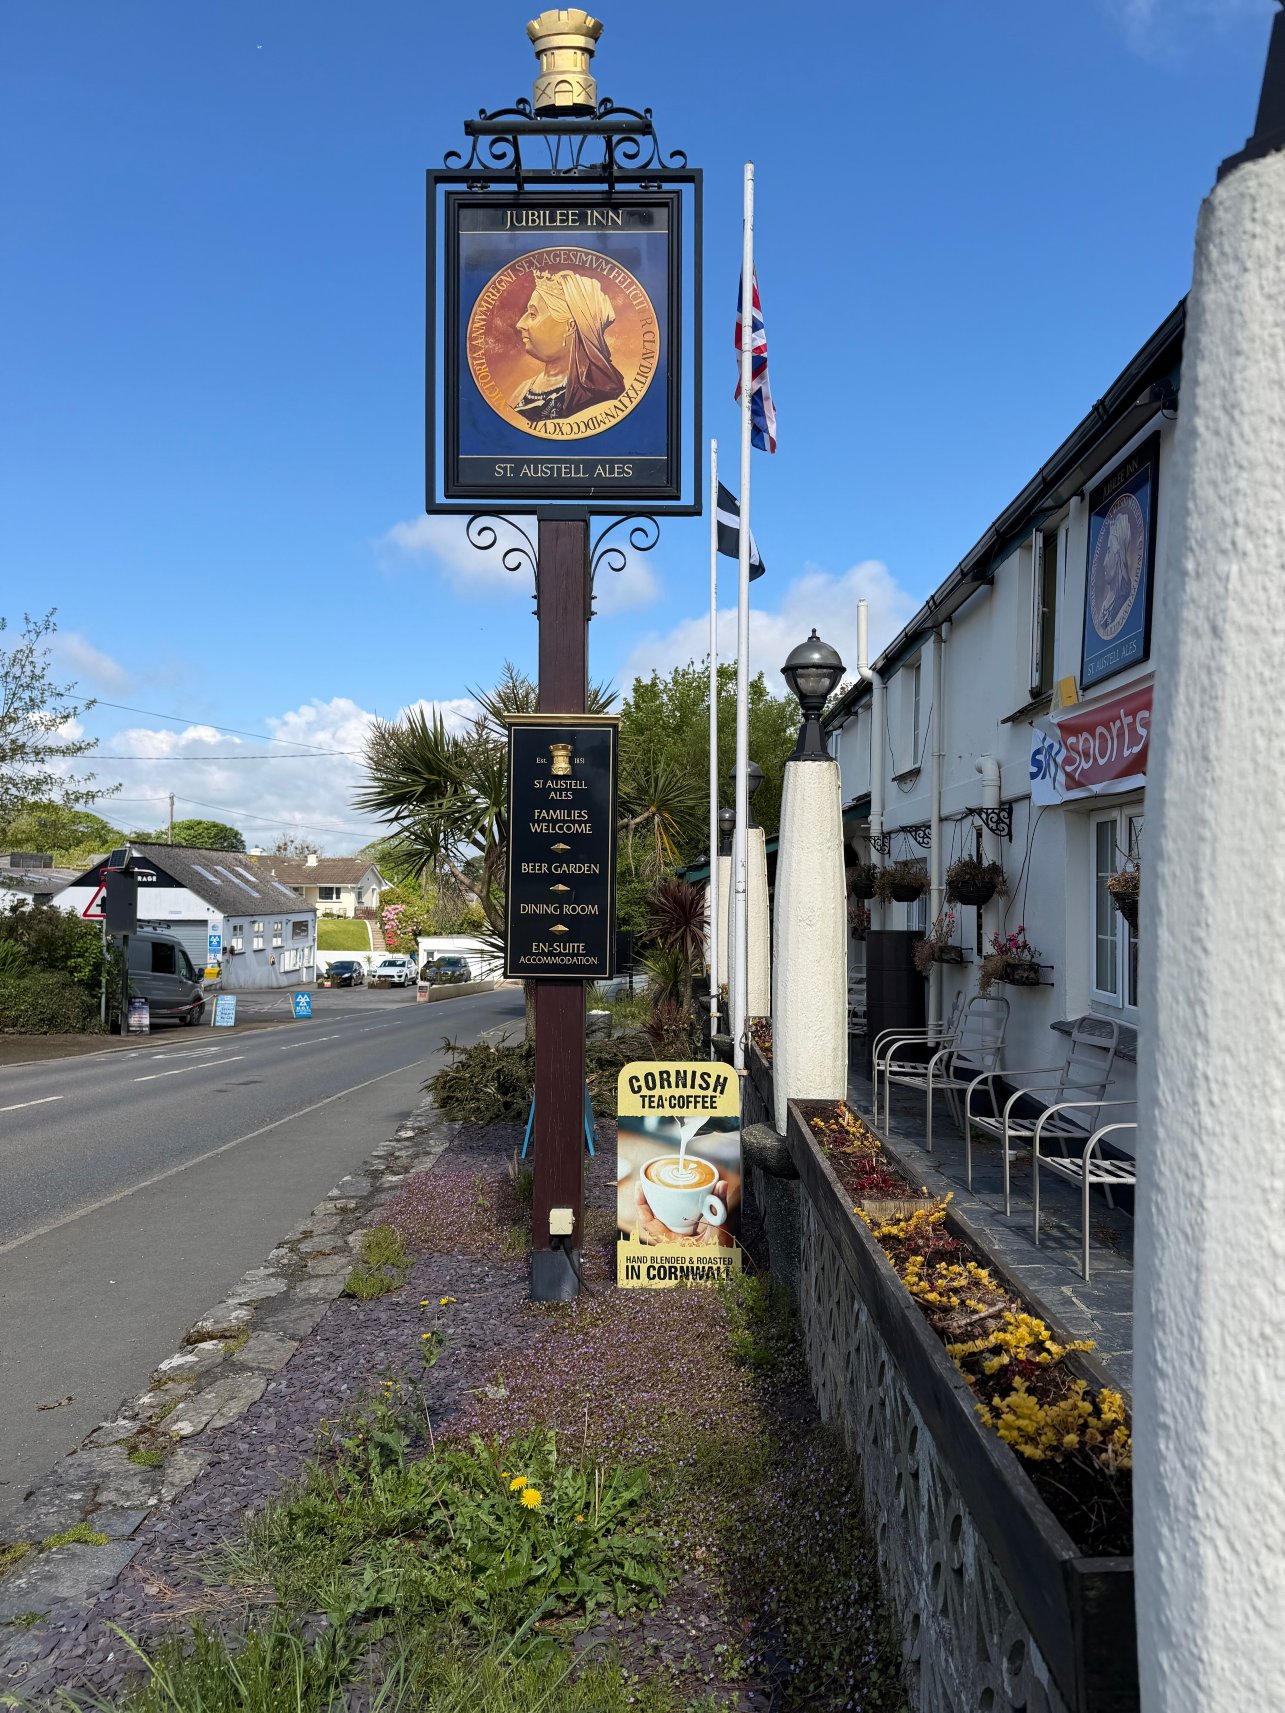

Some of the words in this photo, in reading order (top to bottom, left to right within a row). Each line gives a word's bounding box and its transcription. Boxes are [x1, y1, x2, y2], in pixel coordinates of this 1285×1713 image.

[505, 210, 580, 230] JUBILEE
[587, 210, 623, 226] INN
[494, 464, 514, 477] ST.
[520, 464, 588, 477] AUSTELL
[594, 464, 633, 477] ALES
[1096, 649, 1119, 671] AUSTELL
[1121, 639, 1137, 658] ALES
[1065, 708, 1150, 781] sports
[534, 780, 543, 788] ST
[545, 780, 588, 789] AUSTELL
[548, 791, 573, 800] ALES
[534, 809, 588, 820] FAMILIES
[529, 822, 593, 834] WELCOME
[521, 862, 549, 874] BEER
[551, 863, 600, 875] GARDEN
[520, 904, 560, 915] DINING
[562, 904, 599, 915] ROOM
[532, 942, 586, 954] EN-SUITE
[519, 956, 598, 965] ACCOMMODATION
[628, 1069, 729, 1096] CORNISH
[668, 1095, 718, 1110] COFFEE
[626, 1255, 648, 1264] HAND
[650, 1256, 686, 1265] BLENDED
[688, 1256, 695, 1265] &
[696, 1256, 733, 1266] ROASTED
[625, 1265, 641, 1280] IN
